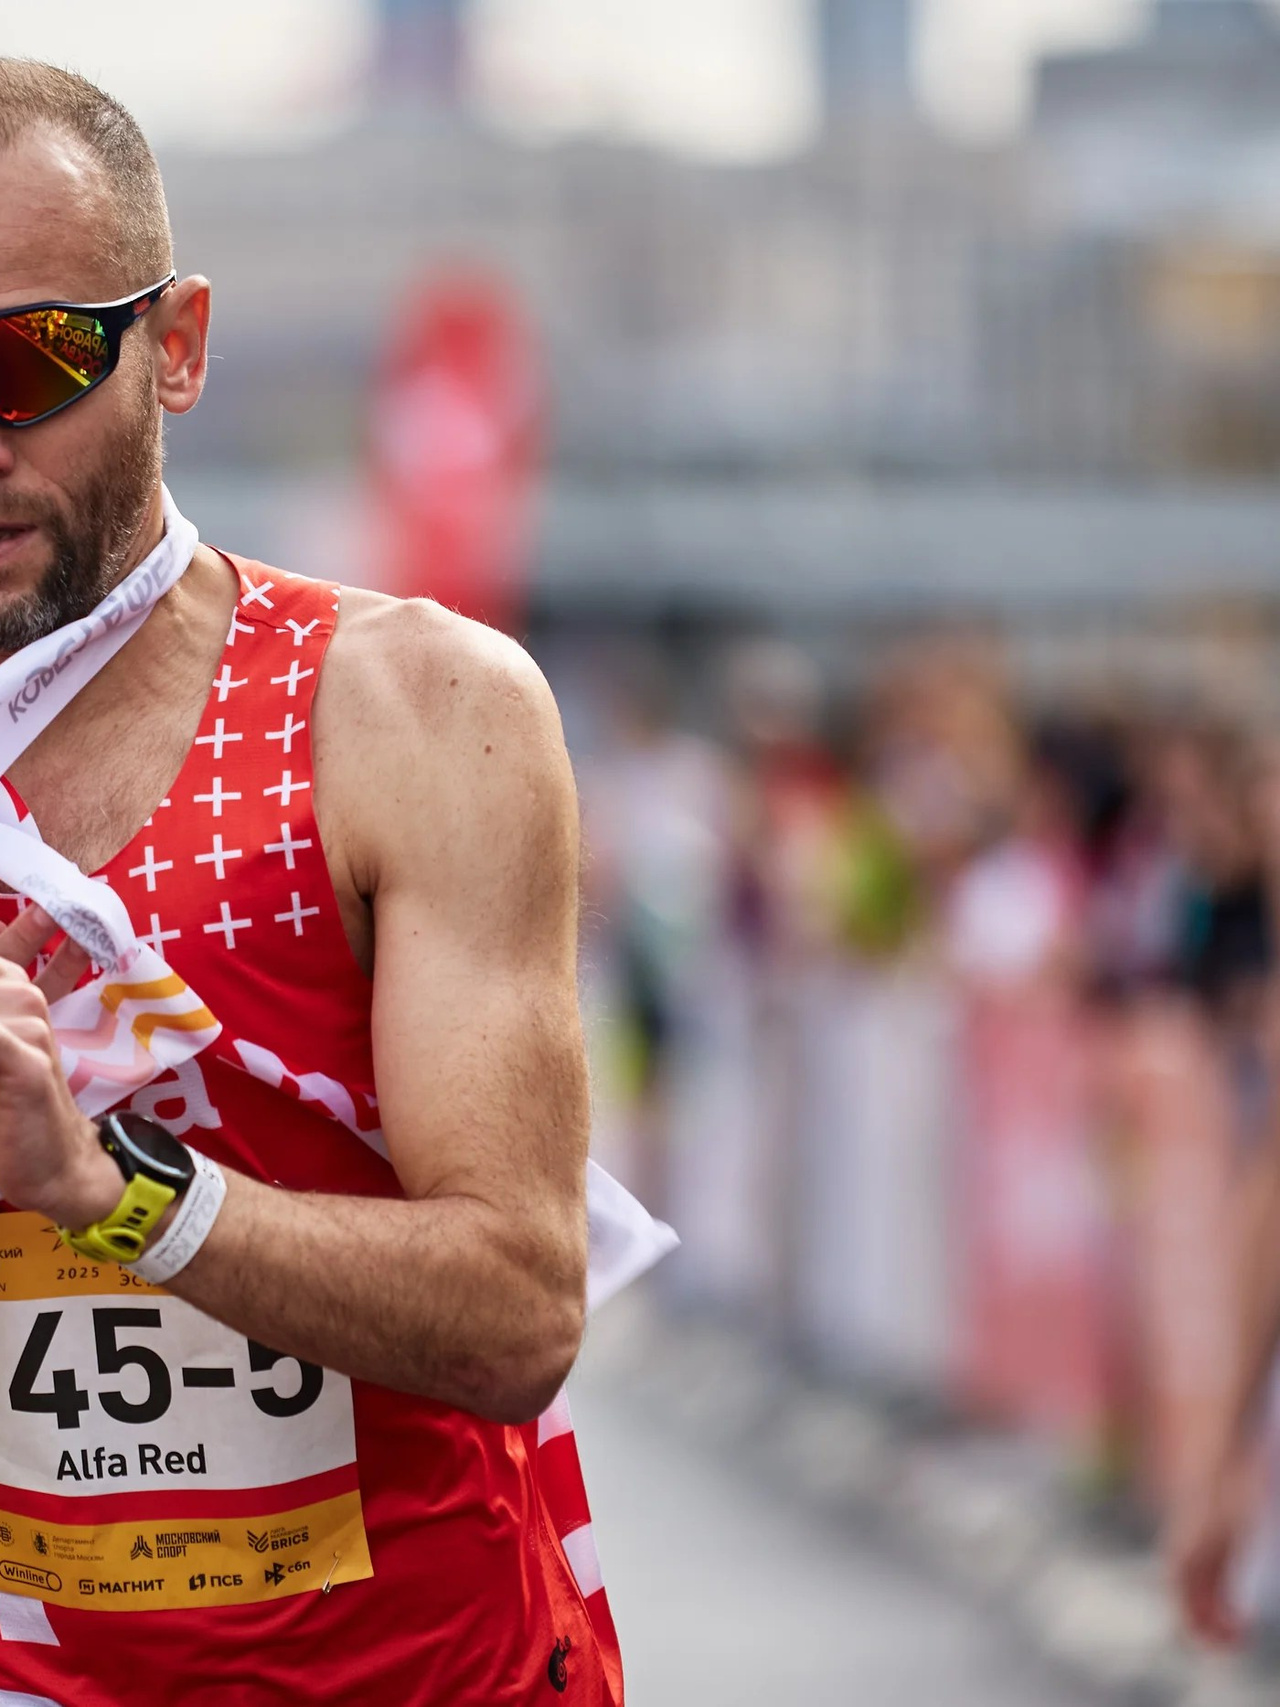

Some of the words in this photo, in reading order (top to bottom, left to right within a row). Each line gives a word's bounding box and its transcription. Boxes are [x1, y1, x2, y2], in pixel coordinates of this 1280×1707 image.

[56, 1267, 99, 1280] 2025
[56, 1446, 128, 1481] Alfa
[139, 1443, 208, 1475] Red
[155, 1529, 221, 1545] МОСКОВСКИЙ
[271, 1532, 310, 1551] BRICS
[156, 1545, 188, 1559] СПОРТ
[4, 1564, 45, 1584] Winline
[287, 1561, 311, 1573] сбп
[99, 1579, 165, 1594] МАГНИТ
[210, 1574, 243, 1588] ПСБ
